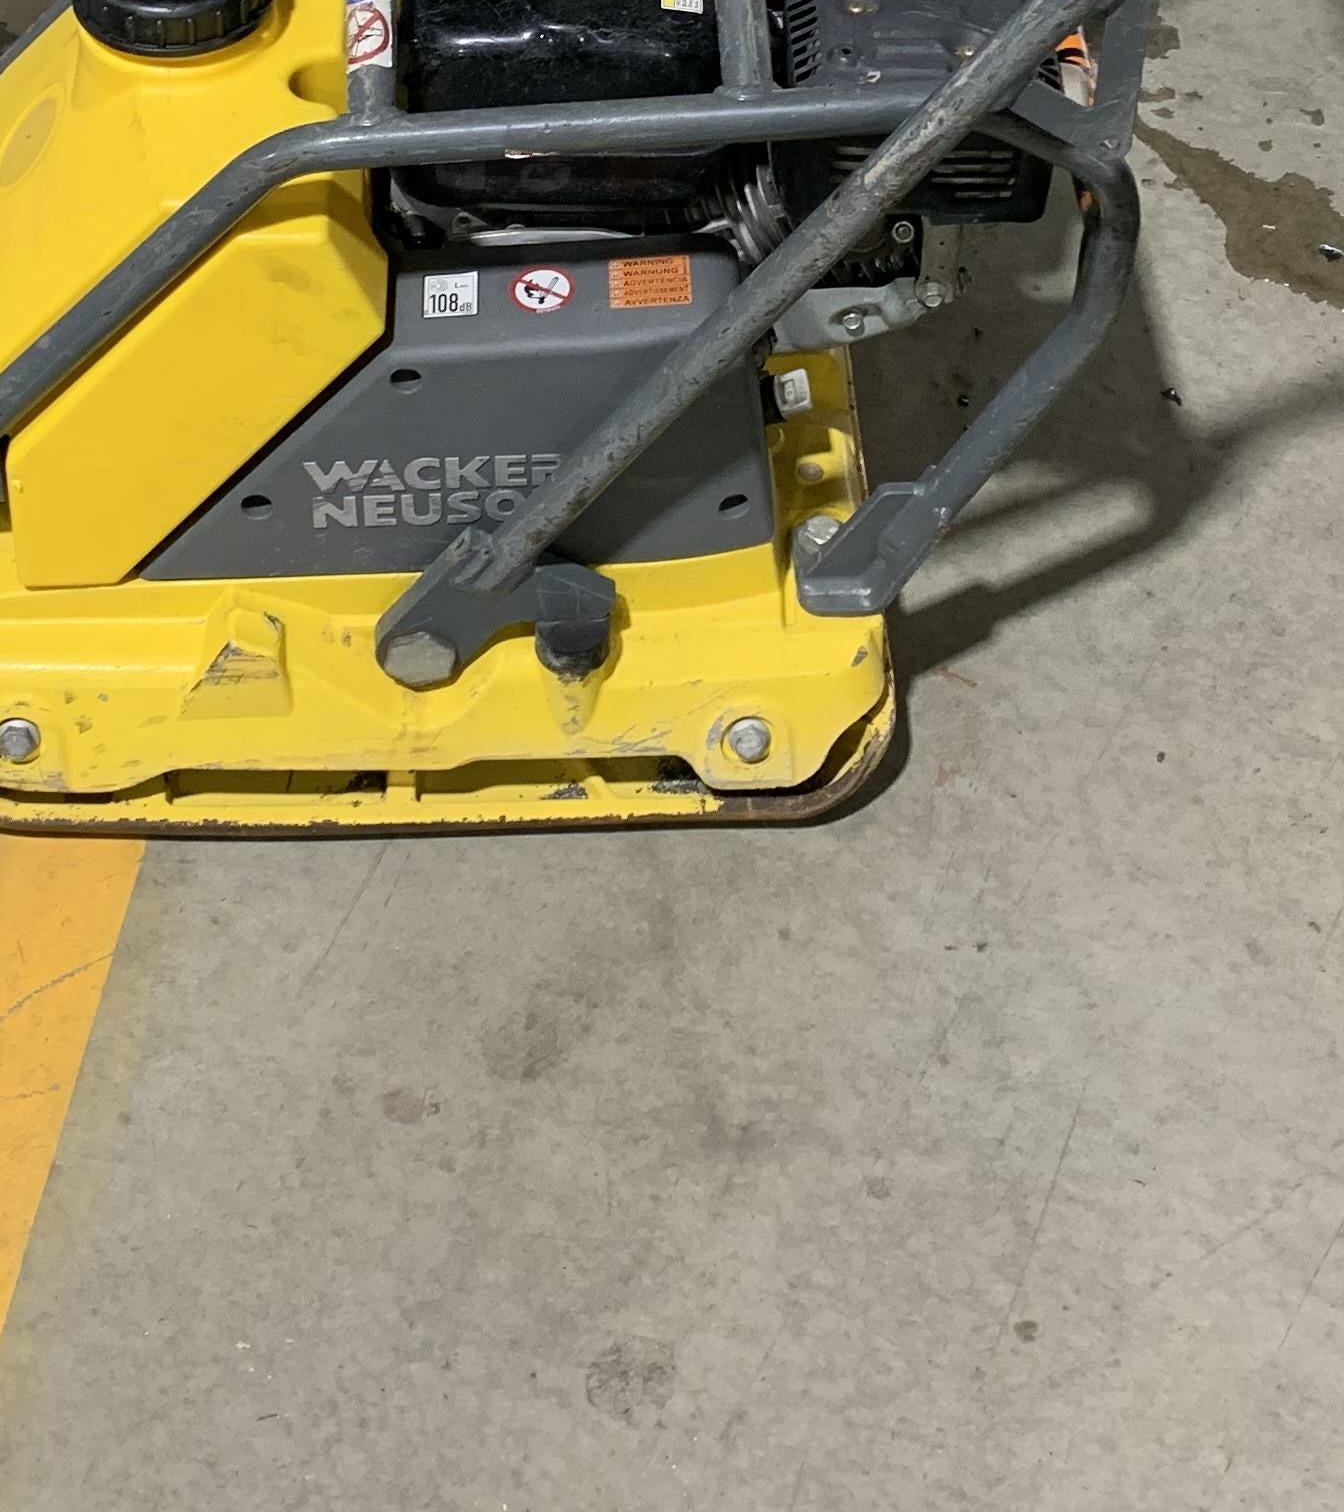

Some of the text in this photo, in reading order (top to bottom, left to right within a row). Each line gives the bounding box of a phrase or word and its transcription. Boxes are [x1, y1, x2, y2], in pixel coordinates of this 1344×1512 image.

[623, 257, 675, 268] WARNING
[623, 267, 679, 277] WARNUNG
[623, 276, 688, 287] ADVERTENCIA
[429, 292, 473, 314] 108 dB
[624, 295, 691, 306] AVVERTENZA
[303, 452, 562, 493] WACKER
[312, 489, 529, 530] NEUSO
